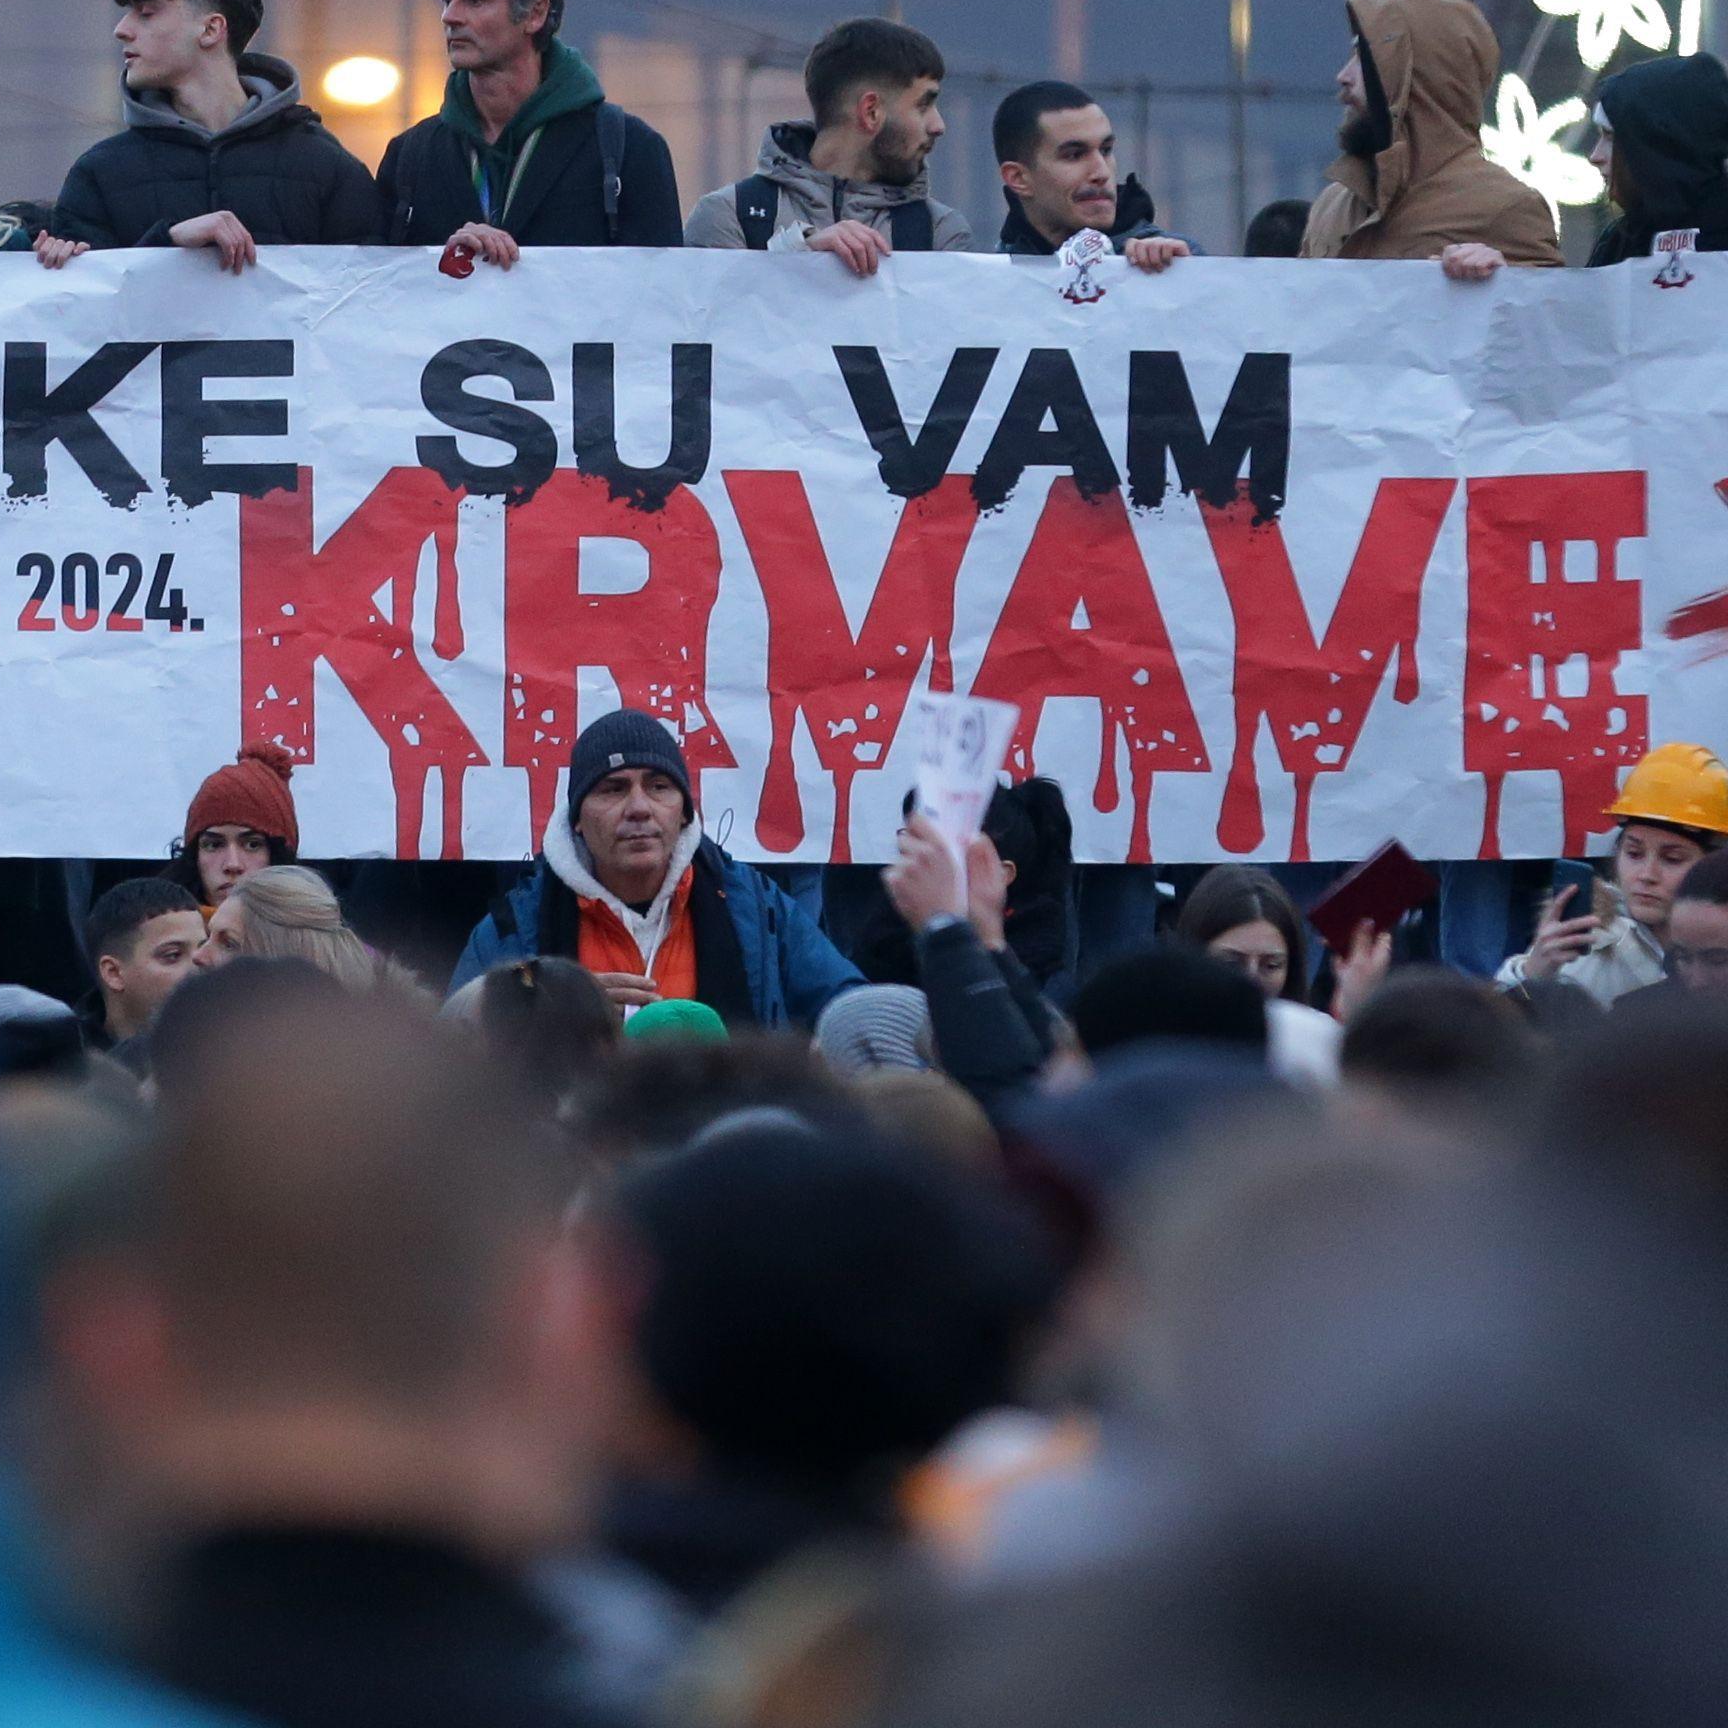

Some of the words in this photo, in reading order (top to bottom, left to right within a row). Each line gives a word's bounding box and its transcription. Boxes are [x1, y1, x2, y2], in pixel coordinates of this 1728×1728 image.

[415, 337, 712, 513] SU
[832, 344, 1292, 527] VAM
[16, 552, 204, 633] 2024.
[239, 465, 1650, 782] KRVAVE
